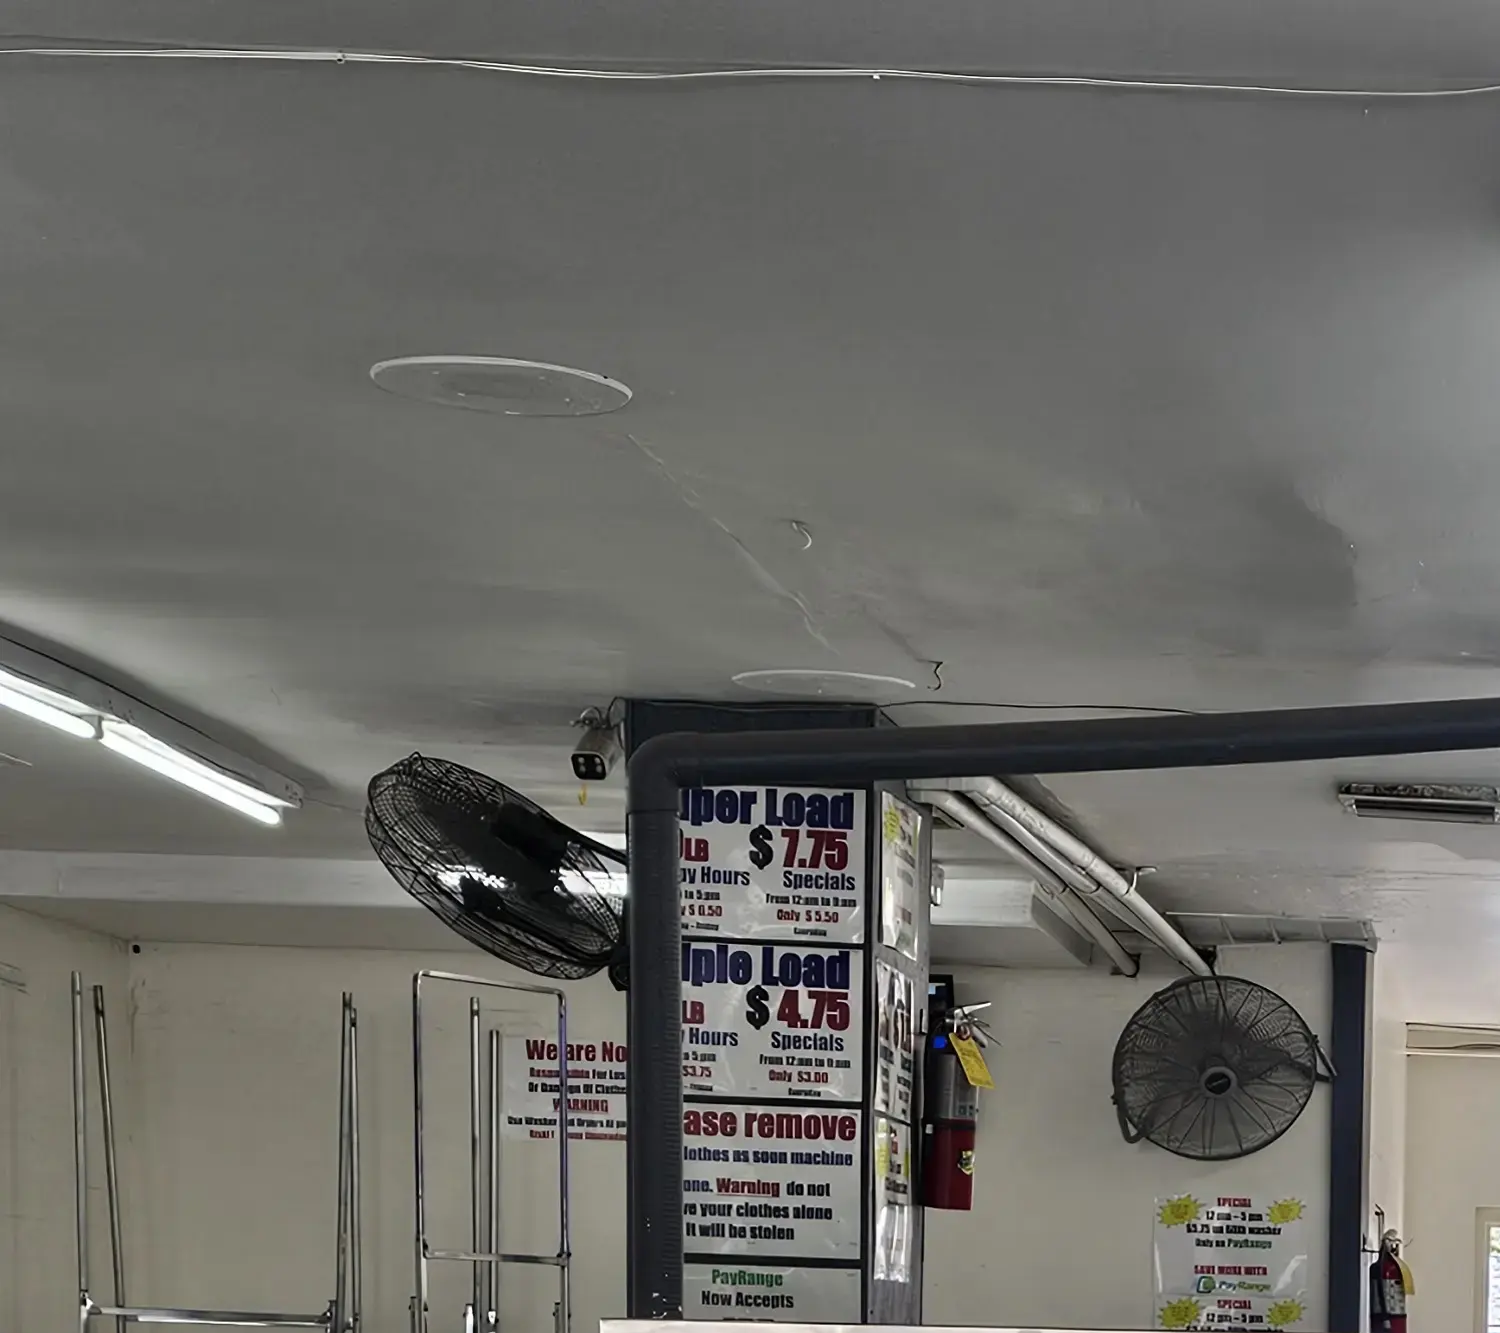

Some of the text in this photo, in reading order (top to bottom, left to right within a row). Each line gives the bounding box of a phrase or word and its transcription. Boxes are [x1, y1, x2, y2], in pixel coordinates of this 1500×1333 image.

[765, 788, 854, 830] Load
[749, 824, 848, 870] $ 7.75
[701, 866, 750, 885] Hours
[783, 870, 856, 891] Specials
[777, 909, 800, 921] Only
[762, 945, 850, 990] Load
[746, 984, 850, 1031] $ 4.75
[689, 1028, 738, 1046] Hours
[771, 1031, 844, 1051] Specials
[526, 1039, 558, 1060] We
[566, 1043, 596, 1061] are
[769, 1069, 792, 1082] Only
[683, 1110, 856, 1141] ase remove
[752, 1150, 787, 1164] soon
[790, 1150, 853, 1166] machine
[716, 1178, 780, 1198] Warning
[786, 1181, 804, 1196] do
[807, 1183, 830, 1197] not
[700, 1203, 733, 1217] your
[736, 1202, 789, 1219] clothes
[793, 1205, 832, 1220] alone
[698, 1223, 725, 1238] will
[729, 1224, 747, 1238] be
[750, 1224, 795, 1240] stolen
[1227, 1238, 1272, 1250] PayRange
[712, 1269, 783, 1287] PayRange
[1219, 1281, 1272, 1293] PayRange
[701, 1290, 794, 1309] Now Accepts
